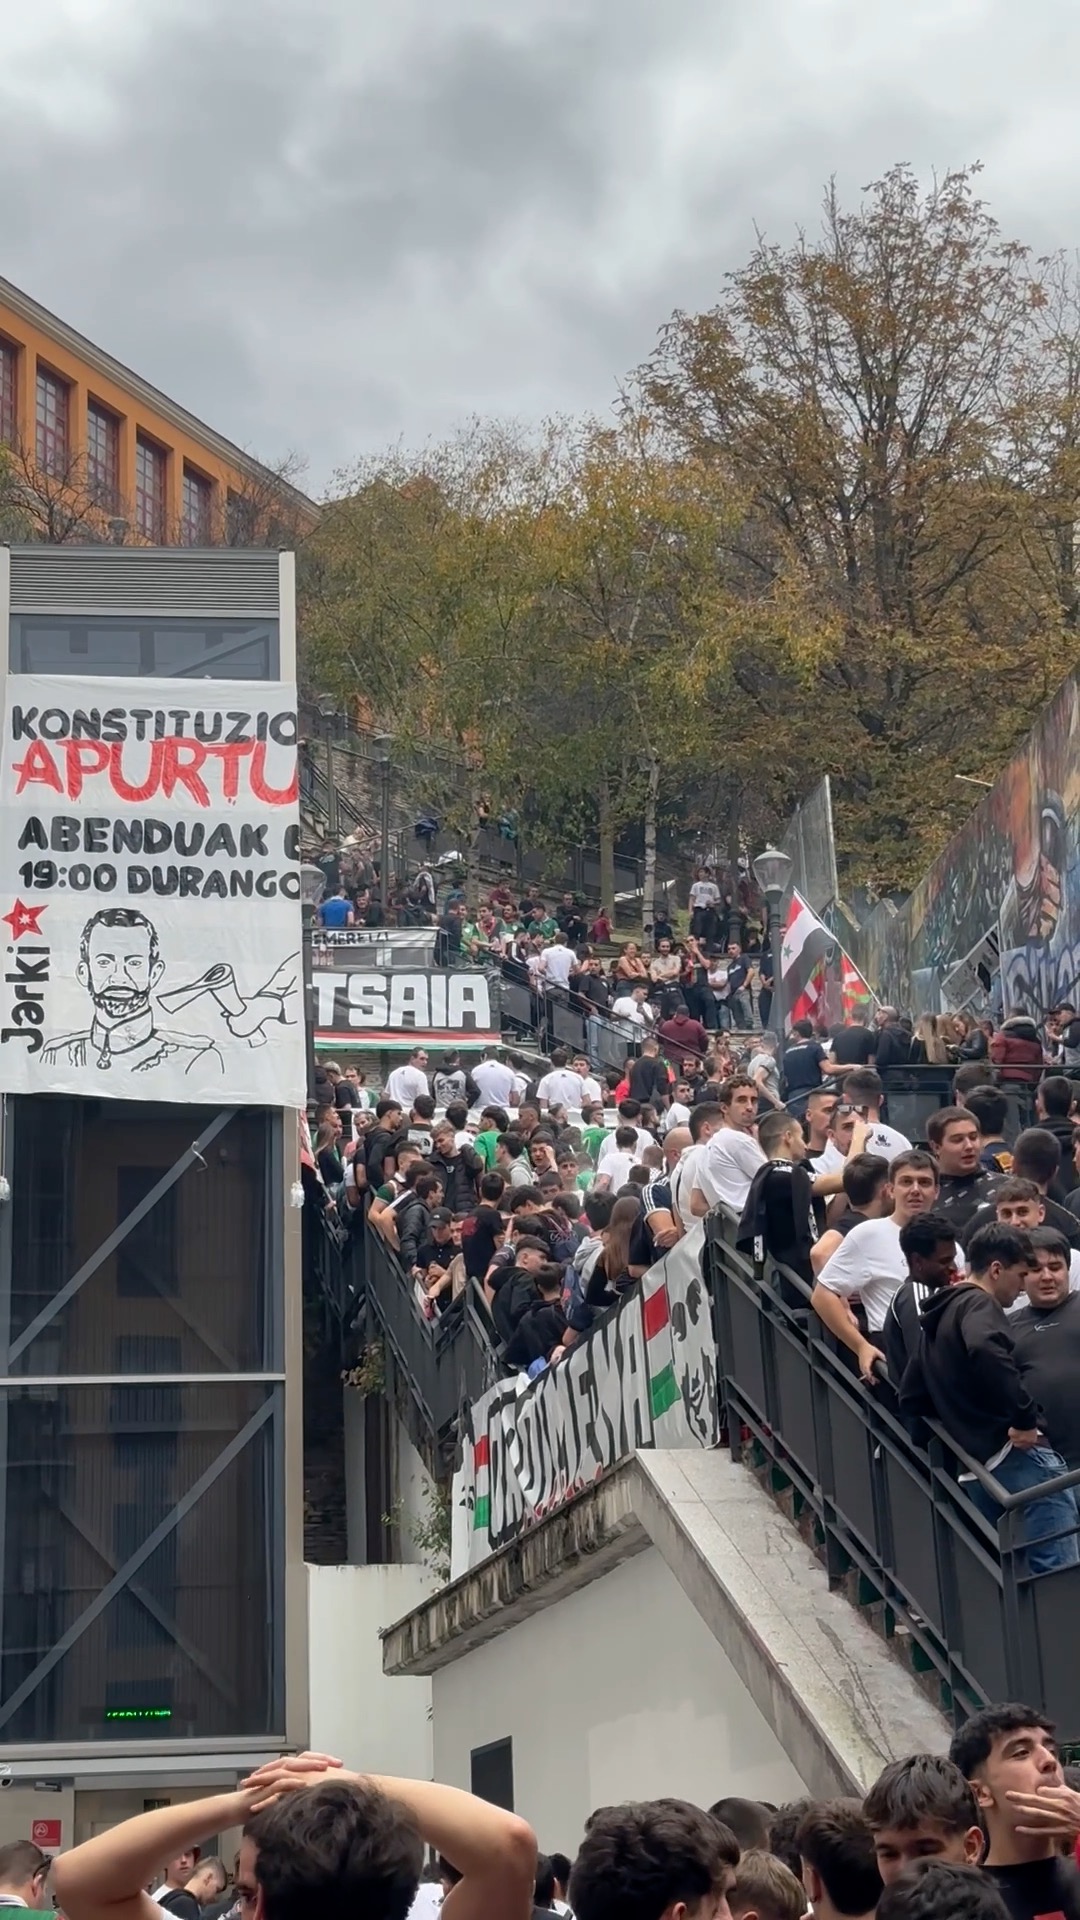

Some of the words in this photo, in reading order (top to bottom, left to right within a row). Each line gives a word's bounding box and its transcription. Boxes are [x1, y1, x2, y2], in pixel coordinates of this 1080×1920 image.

[12, 705, 298, 747] KONSTITUZIO
[12, 735, 299, 807] APURTU
[18, 816, 268, 859] ABENDUAK
[18, 860, 117, 892] 19:00
[127, 865, 300, 900] DURANGO
[1, 945, 50, 1054] Jarki
[312, 973, 491, 1029] TSAIA
